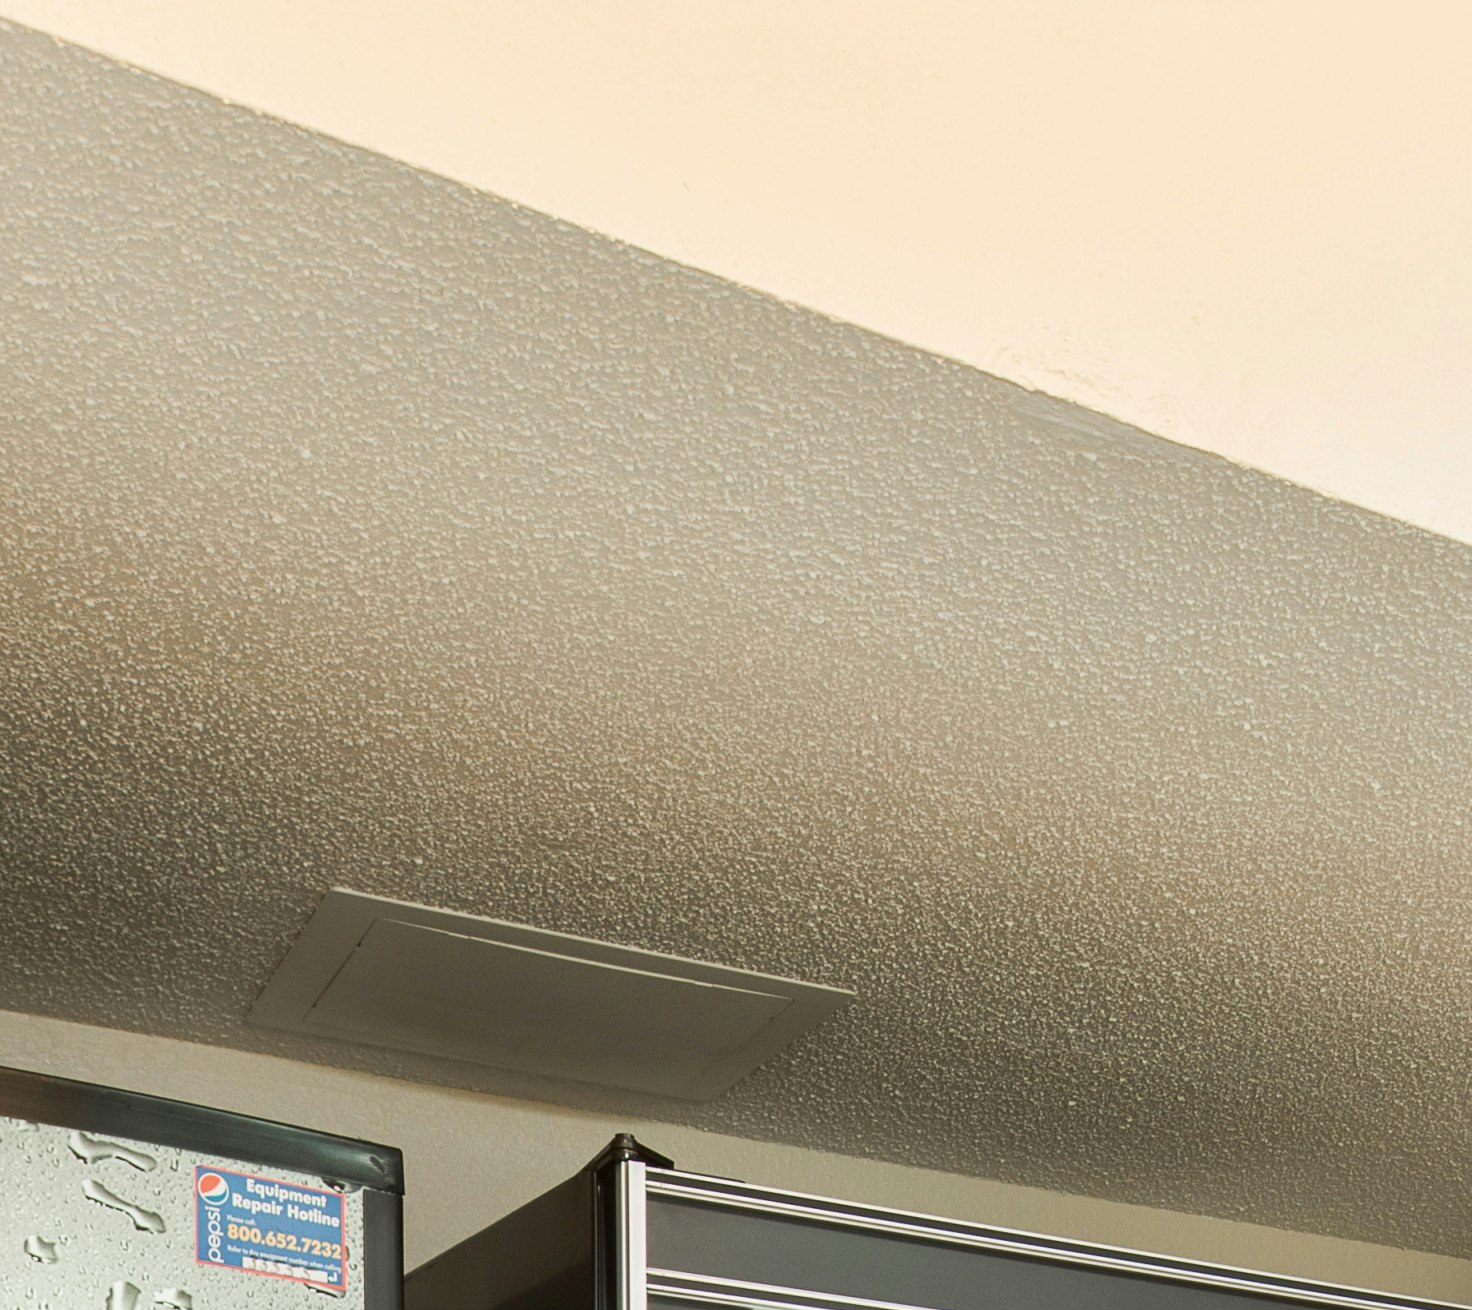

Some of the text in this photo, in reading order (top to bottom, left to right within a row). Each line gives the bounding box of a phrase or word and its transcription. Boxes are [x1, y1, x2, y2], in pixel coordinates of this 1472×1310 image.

[231, 1193, 340, 1227] Repair Hotline
[246, 1178, 327, 1208] Equipment
[205, 1205, 225, 1264] pepsi
[227, 1223, 342, 1260] 800.652.7232
